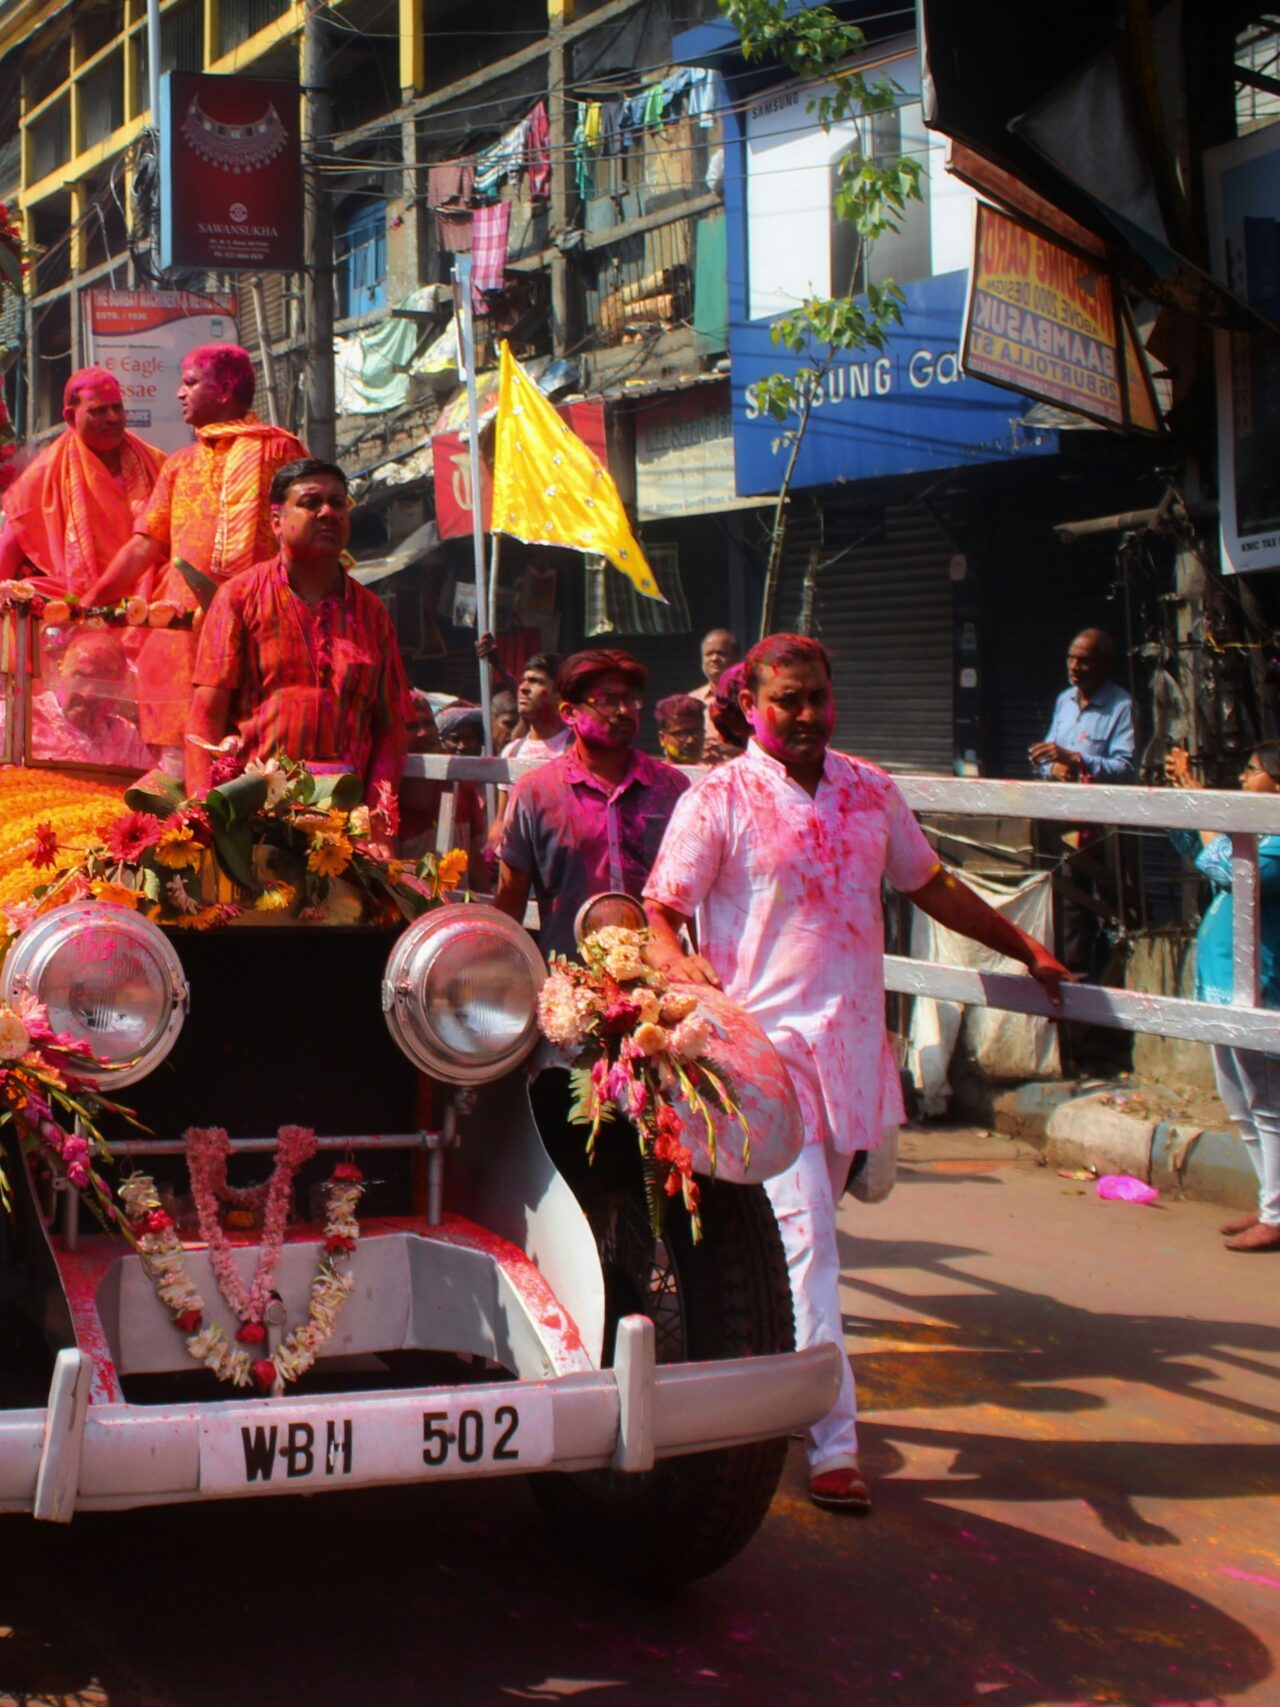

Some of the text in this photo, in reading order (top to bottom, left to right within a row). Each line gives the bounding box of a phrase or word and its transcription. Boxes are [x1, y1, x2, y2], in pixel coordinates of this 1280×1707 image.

[752, 92, 799, 119] SAMSUNG
[198, 223, 278, 237] SAWANSUKHA
[121, 356, 166, 378] Eagle
[909, 351, 967, 389] Ga
[241, 1405, 520, 1482] WBH 502
